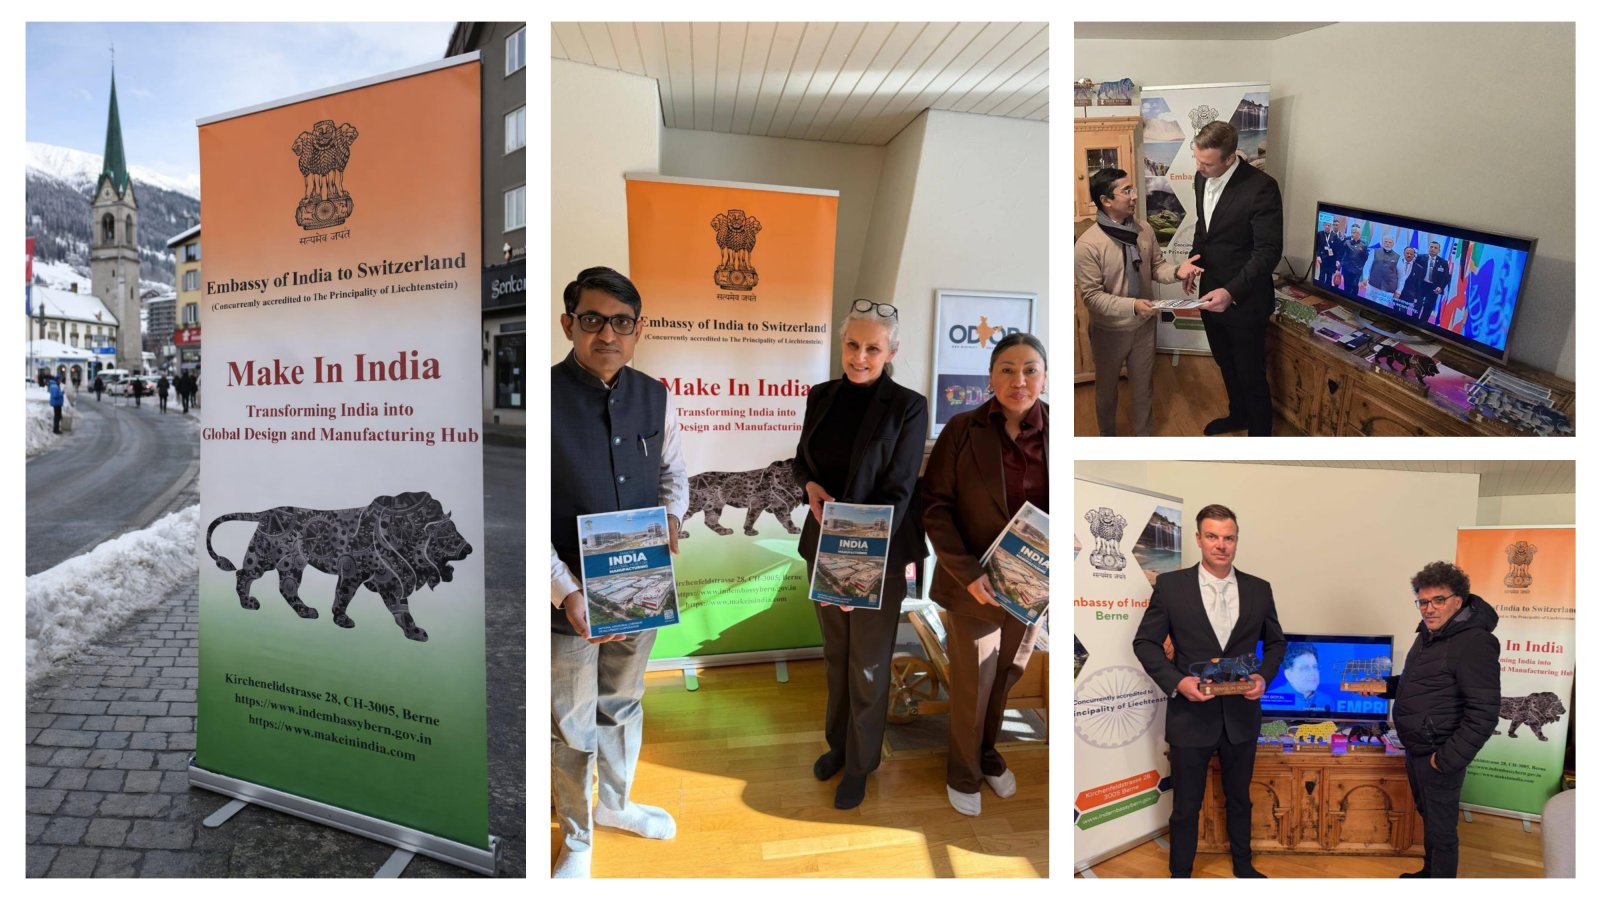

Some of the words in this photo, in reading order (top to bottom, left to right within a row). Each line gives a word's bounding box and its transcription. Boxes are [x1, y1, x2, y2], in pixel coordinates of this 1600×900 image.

[1170, 173, 1194, 181] Emba
[207, 278, 270, 295] Embassy
[274, 272, 290, 288] of
[292, 268, 332, 286] India
[337, 267, 352, 280] to
[358, 252, 466, 278] Switzerland
[262, 294, 302, 306] accredited
[313, 293, 328, 301] The
[330, 288, 377, 300] Principality
[380, 286, 389, 294] of
[391, 280, 458, 294] Liechtenstein)
[640, 316, 694, 332] Embassy
[698, 318, 710, 330] of
[714, 318, 744, 330] India
[748, 322, 758, 331] to
[762, 321, 826, 333] Switzerland
[644, 333, 688, 342] (Concurrently
[226, 358, 304, 386] Make
[313, 356, 344, 384] In
[354, 350, 442, 382] India
[660, 377, 720, 396] Make
[728, 378, 750, 396] In
[758, 378, 812, 397] India
[246, 404, 336, 420] Transforming
[341, 402, 378, 416] India
[384, 402, 414, 416] into
[676, 407, 746, 418] Transforming
[750, 408, 774, 416] India
[777, 408, 796, 417] into
[712, 422, 731, 431] and
[734, 422, 803, 432] Manufacturin
[202, 428, 240, 440] Global
[244, 428, 286, 444] Design
[291, 428, 316, 440] and
[320, 427, 436, 446] Manufacturing
[440, 428, 478, 442] Hub
[840, 539, 868, 549] INDIA
[608, 552, 648, 566] INDIA
[1020, 546, 1049, 568] INDIA
[1074, 596, 1114, 610] mbassy
[1116, 598, 1129, 608] of
[1096, 610, 1128, 620] Berne
[1506, 640, 1520, 651] In
[1526, 640, 1564, 654] India
[1506, 666, 1558, 676] Manufacturing
[1116, 690, 1146, 699] accredited
[325, 692, 341, 705] 28,
[344, 696, 399, 719] CH-3005,
[402, 708, 440, 726] Berne
[1074, 704, 1115, 716] incipality
[1128, 696, 1168, 708] Liechtenst
[235, 693, 432, 746] https://www.indembassybern.gov.in
[249, 714, 416, 762] https://www.makeinindia.com
[1104, 790, 1120, 800] 3005
[1122, 785, 1140, 794] Berne
